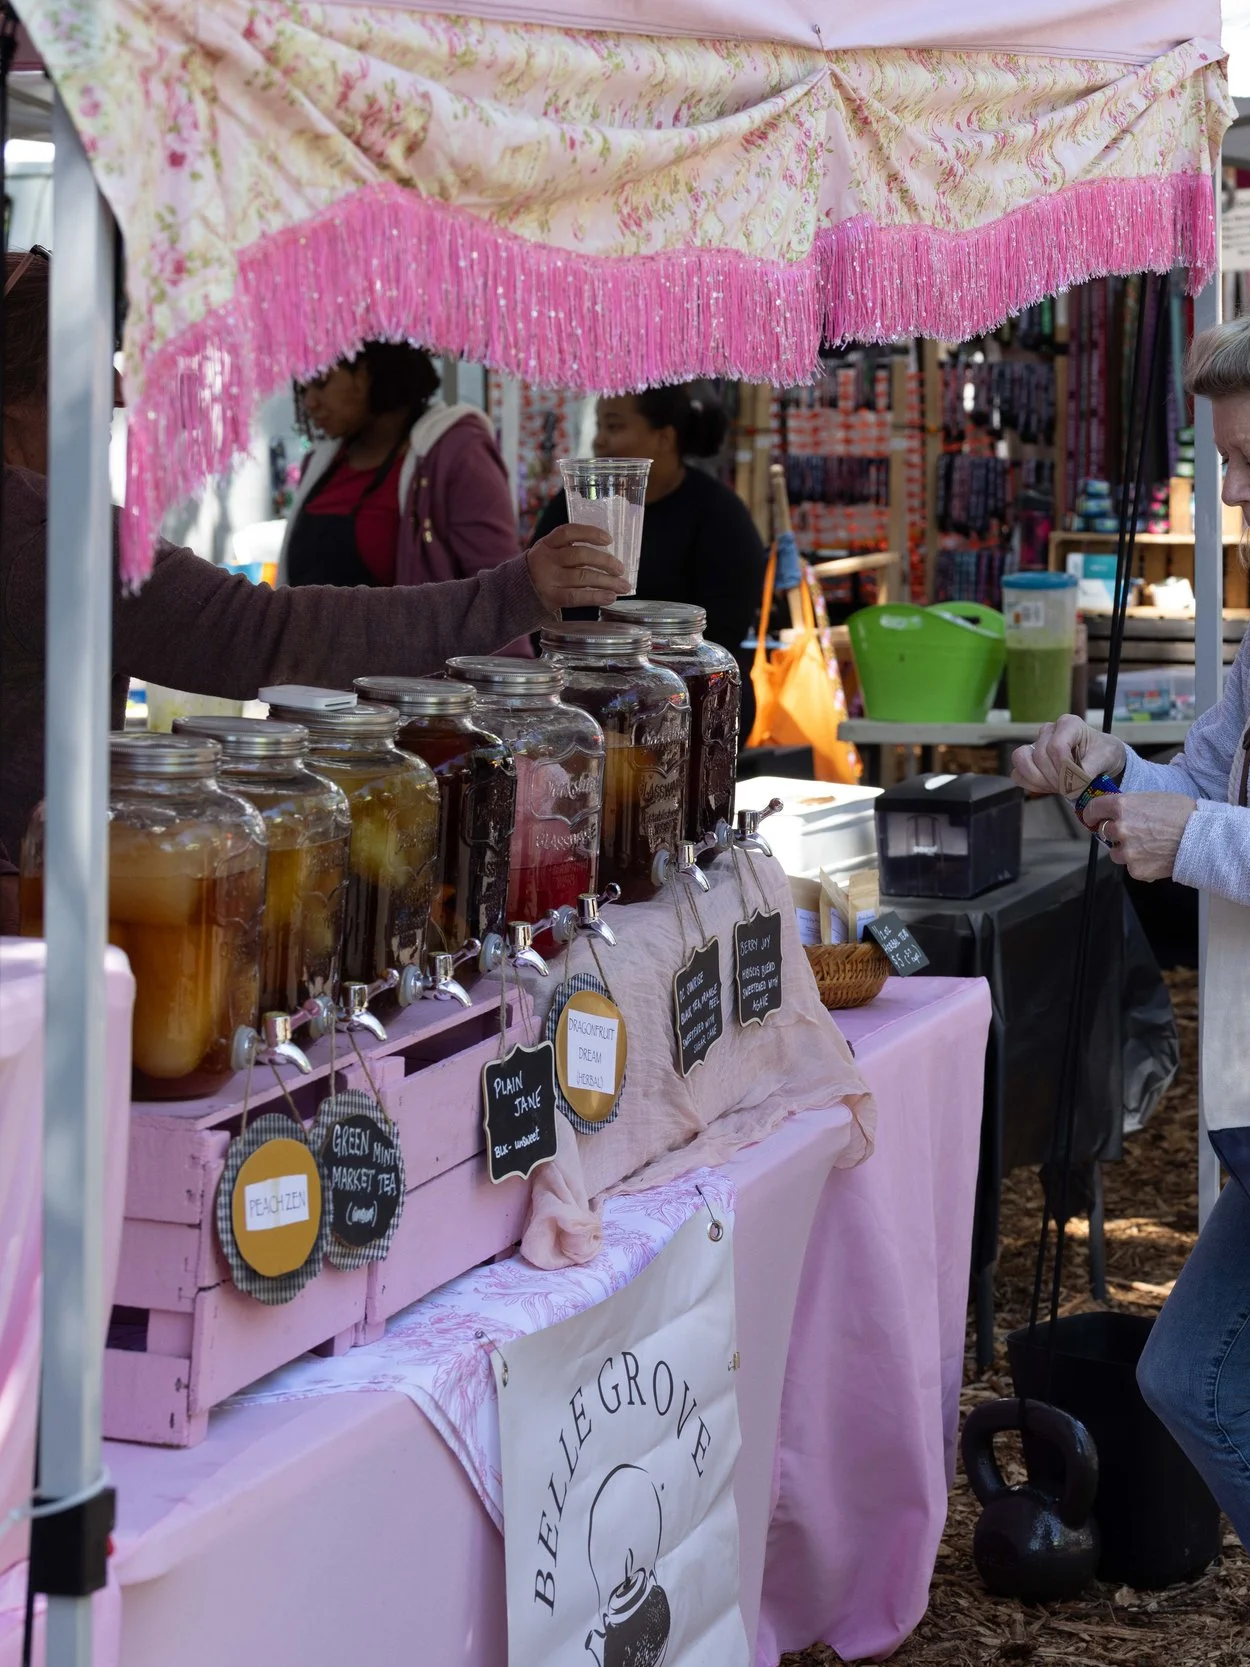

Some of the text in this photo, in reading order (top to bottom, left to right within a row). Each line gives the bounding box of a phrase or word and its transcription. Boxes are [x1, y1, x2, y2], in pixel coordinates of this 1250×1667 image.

[740, 938, 758, 956] BERRY
[568, 1017, 616, 1041] DRAGONFRUIT
[578, 1046, 602, 1064] DREAM
[493, 1070, 523, 1099] PLAIN
[514, 1085, 542, 1117] JANE
[332, 1124, 396, 1168] GREEN MINT
[331, 1166, 397, 1196] MARKET TEA
[534, 1350, 712, 1616] BELLE GROVE
